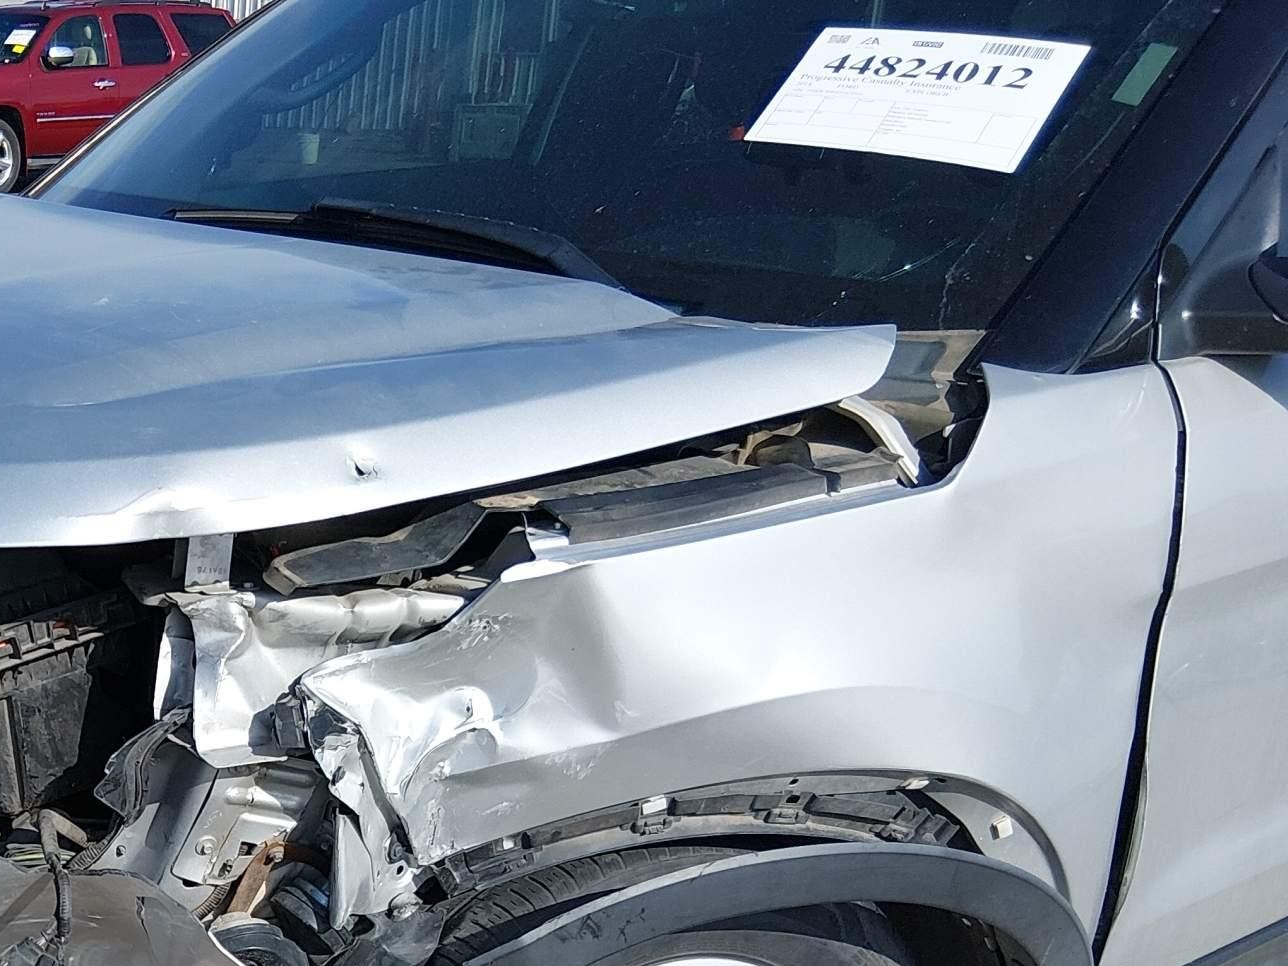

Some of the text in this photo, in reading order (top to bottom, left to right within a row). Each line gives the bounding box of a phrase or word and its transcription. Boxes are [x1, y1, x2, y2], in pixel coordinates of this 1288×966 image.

[800, 73, 961, 91] Progressive Casualty Insurance
[824, 53, 1033, 89] 44824012
